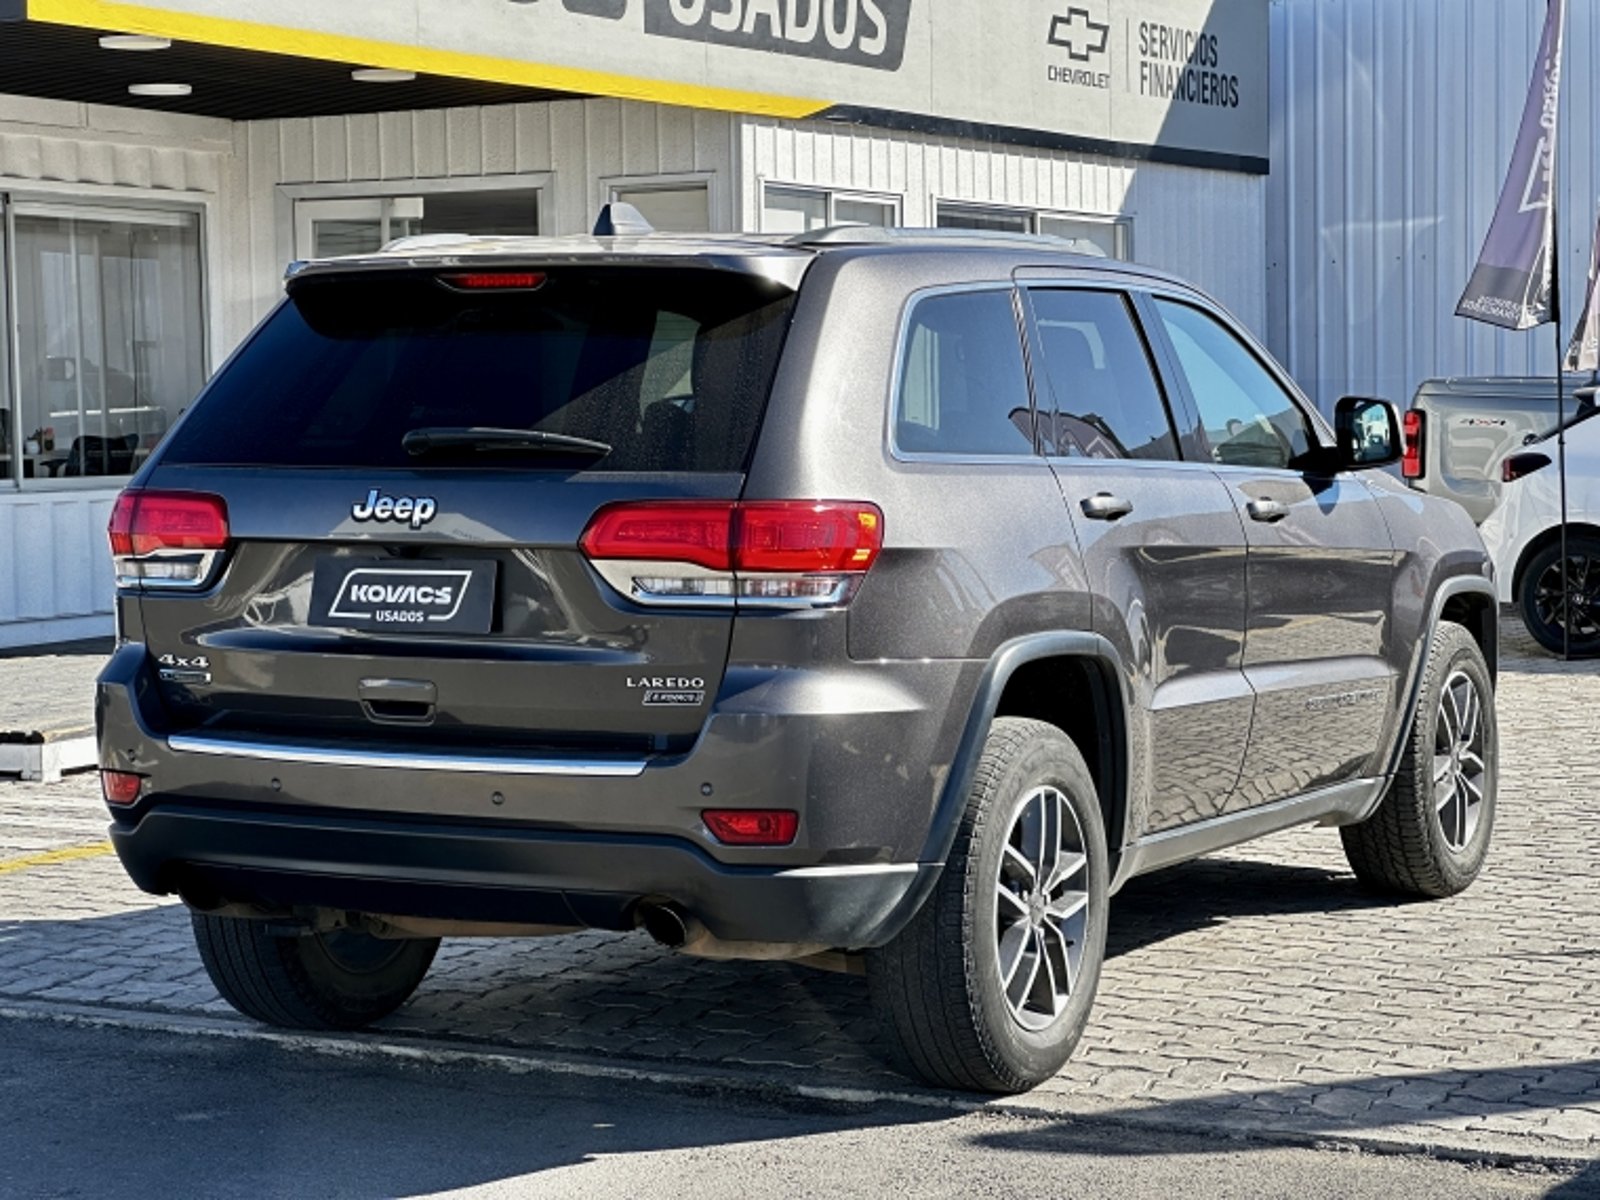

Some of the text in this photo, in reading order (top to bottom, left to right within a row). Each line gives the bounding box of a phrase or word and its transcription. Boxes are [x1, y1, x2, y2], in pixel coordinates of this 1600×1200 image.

[668, 0, 888, 56] DOS
[1138, 21, 1218, 68] SERVICIOS
[1048, 65, 1110, 89] CHEVROLET
[1140, 60, 1239, 108] FINANCIEROS
[352, 488, 437, 529] Jeep
[350, 584, 453, 605] KOVACS
[375, 610, 425, 623] USADOS
[626, 677, 704, 688] LAREDO
